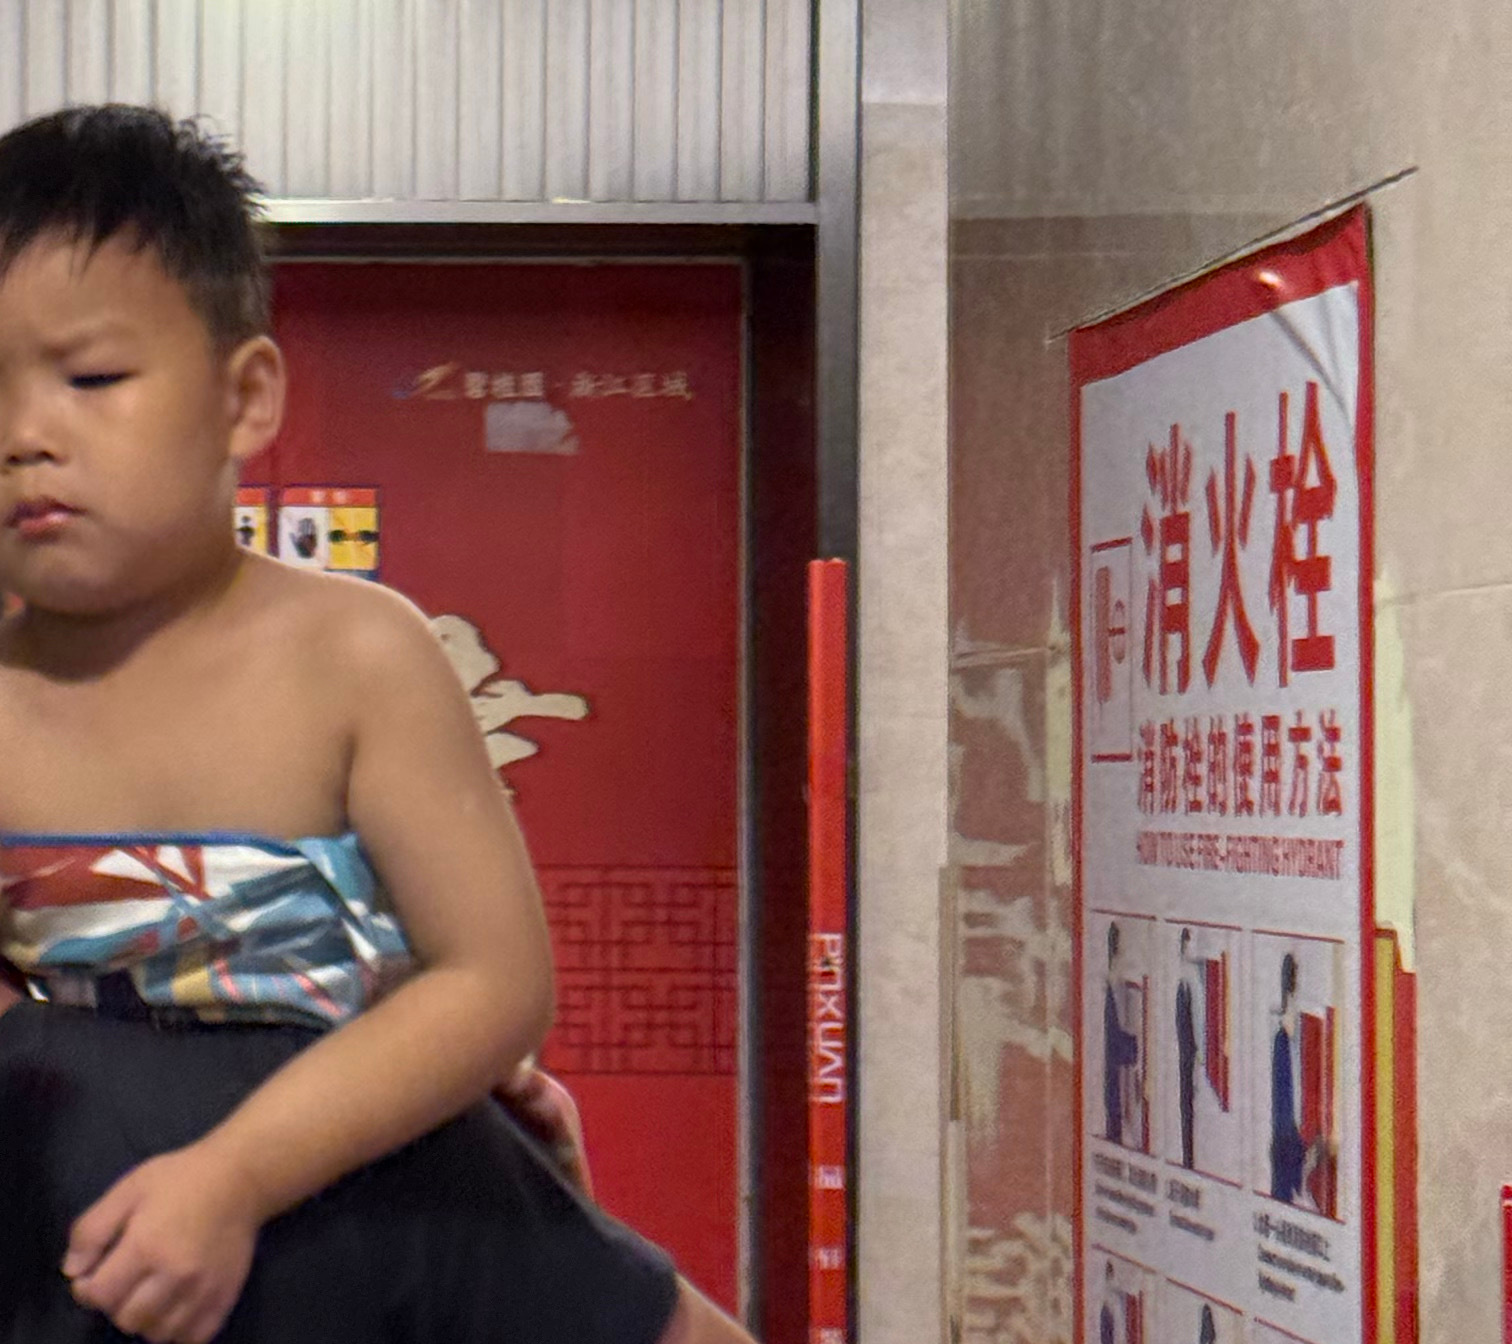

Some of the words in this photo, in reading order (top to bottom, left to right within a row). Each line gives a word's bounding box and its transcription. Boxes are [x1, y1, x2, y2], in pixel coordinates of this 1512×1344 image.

[1140, 381, 1337, 696] 消火栓
[1137, 709, 1344, 818] 消防栓的使用方法
